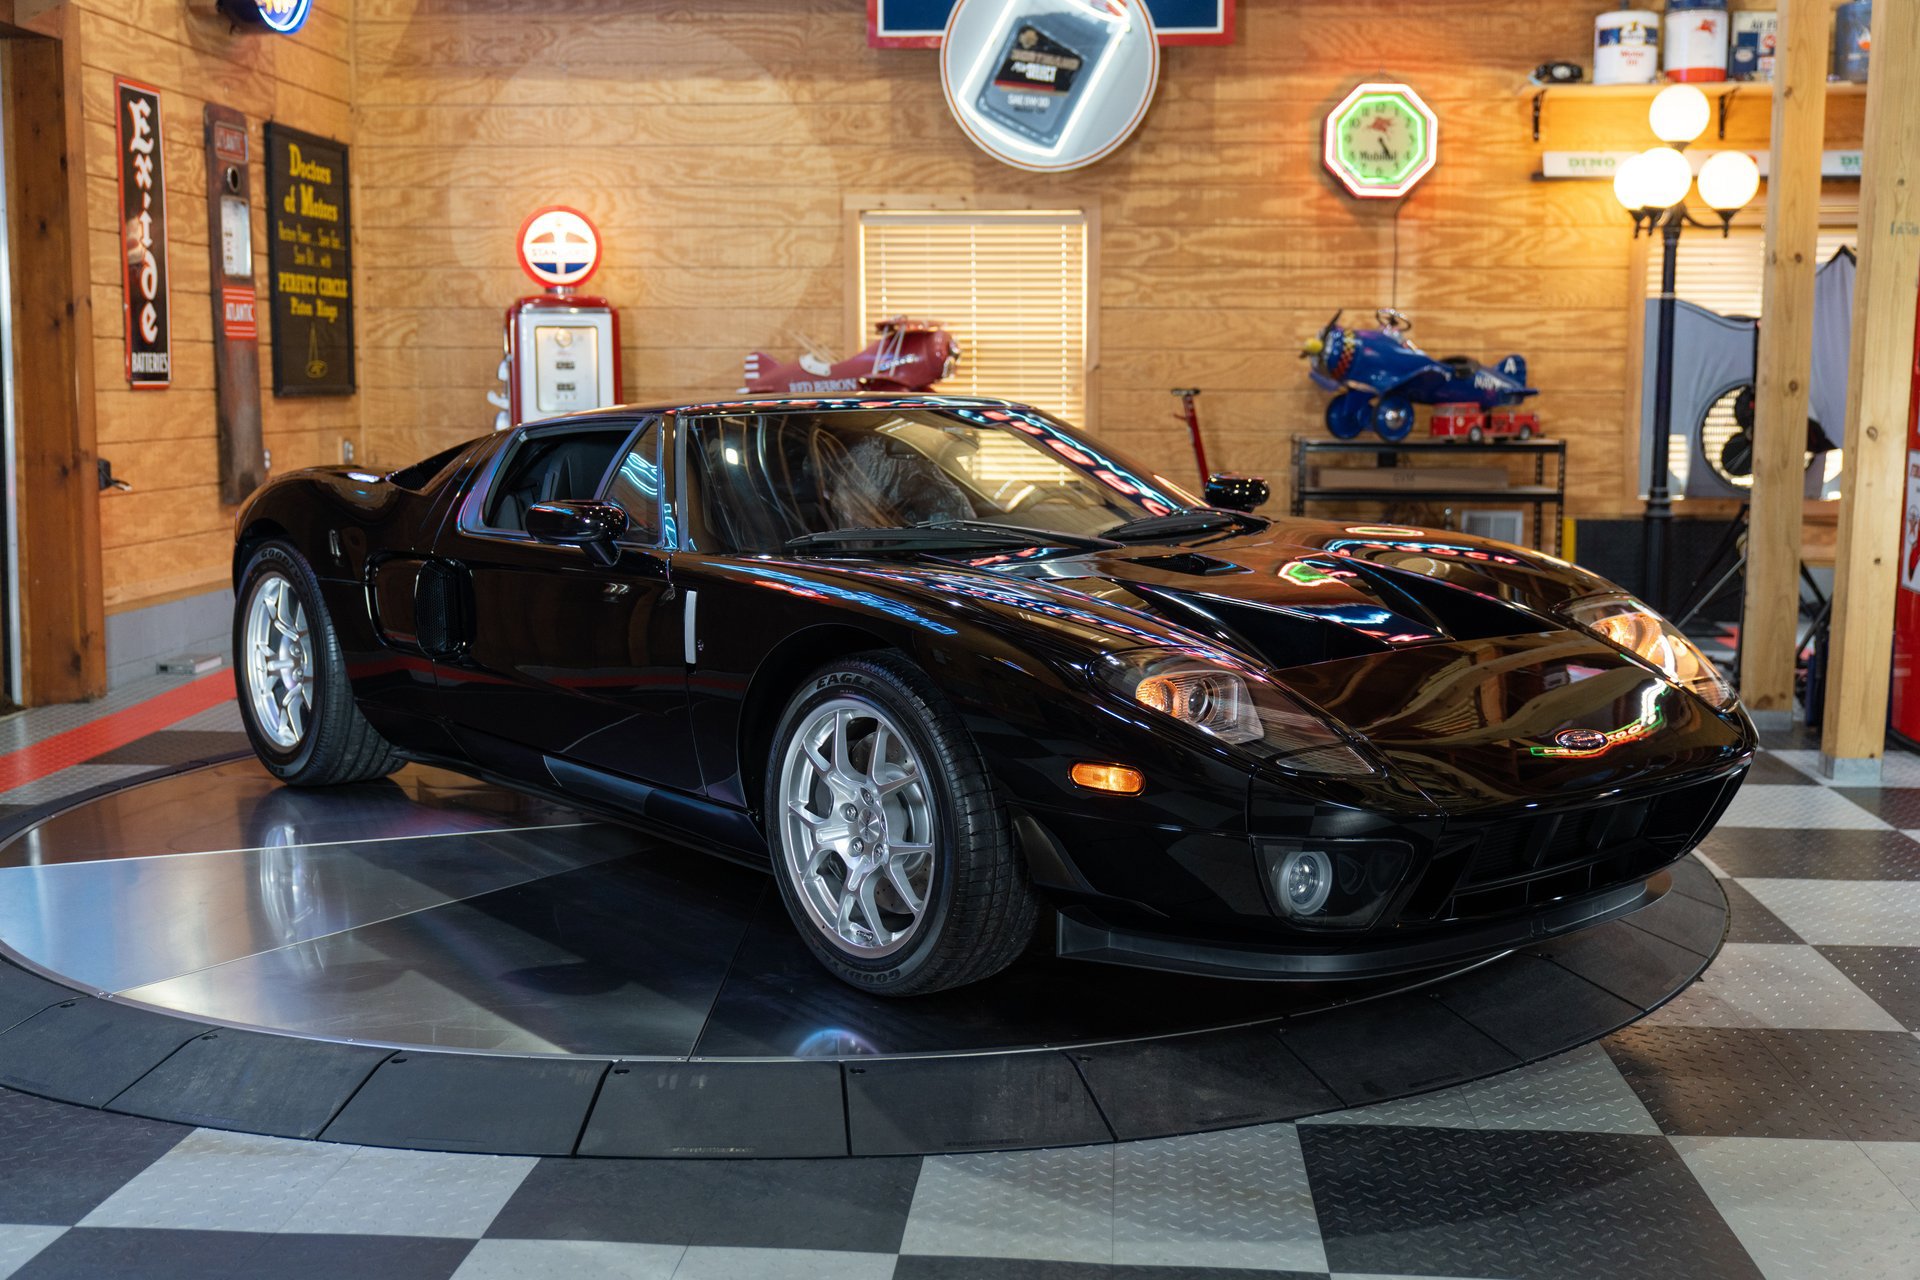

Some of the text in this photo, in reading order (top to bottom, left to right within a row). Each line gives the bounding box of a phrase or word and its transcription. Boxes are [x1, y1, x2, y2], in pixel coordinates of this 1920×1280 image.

[288, 143, 332, 185] Doctors
[1568, 156, 1616, 168] DINO
[300, 183, 338, 222] Motors
[279, 271, 348, 299] PERFECT CIRCLE
[132, 352, 168, 374] BATTERIES
[1504, 357, 1517, 374] A
[814, 378, 857, 393] BARON
[816, 673, 881, 692] EAGLE
